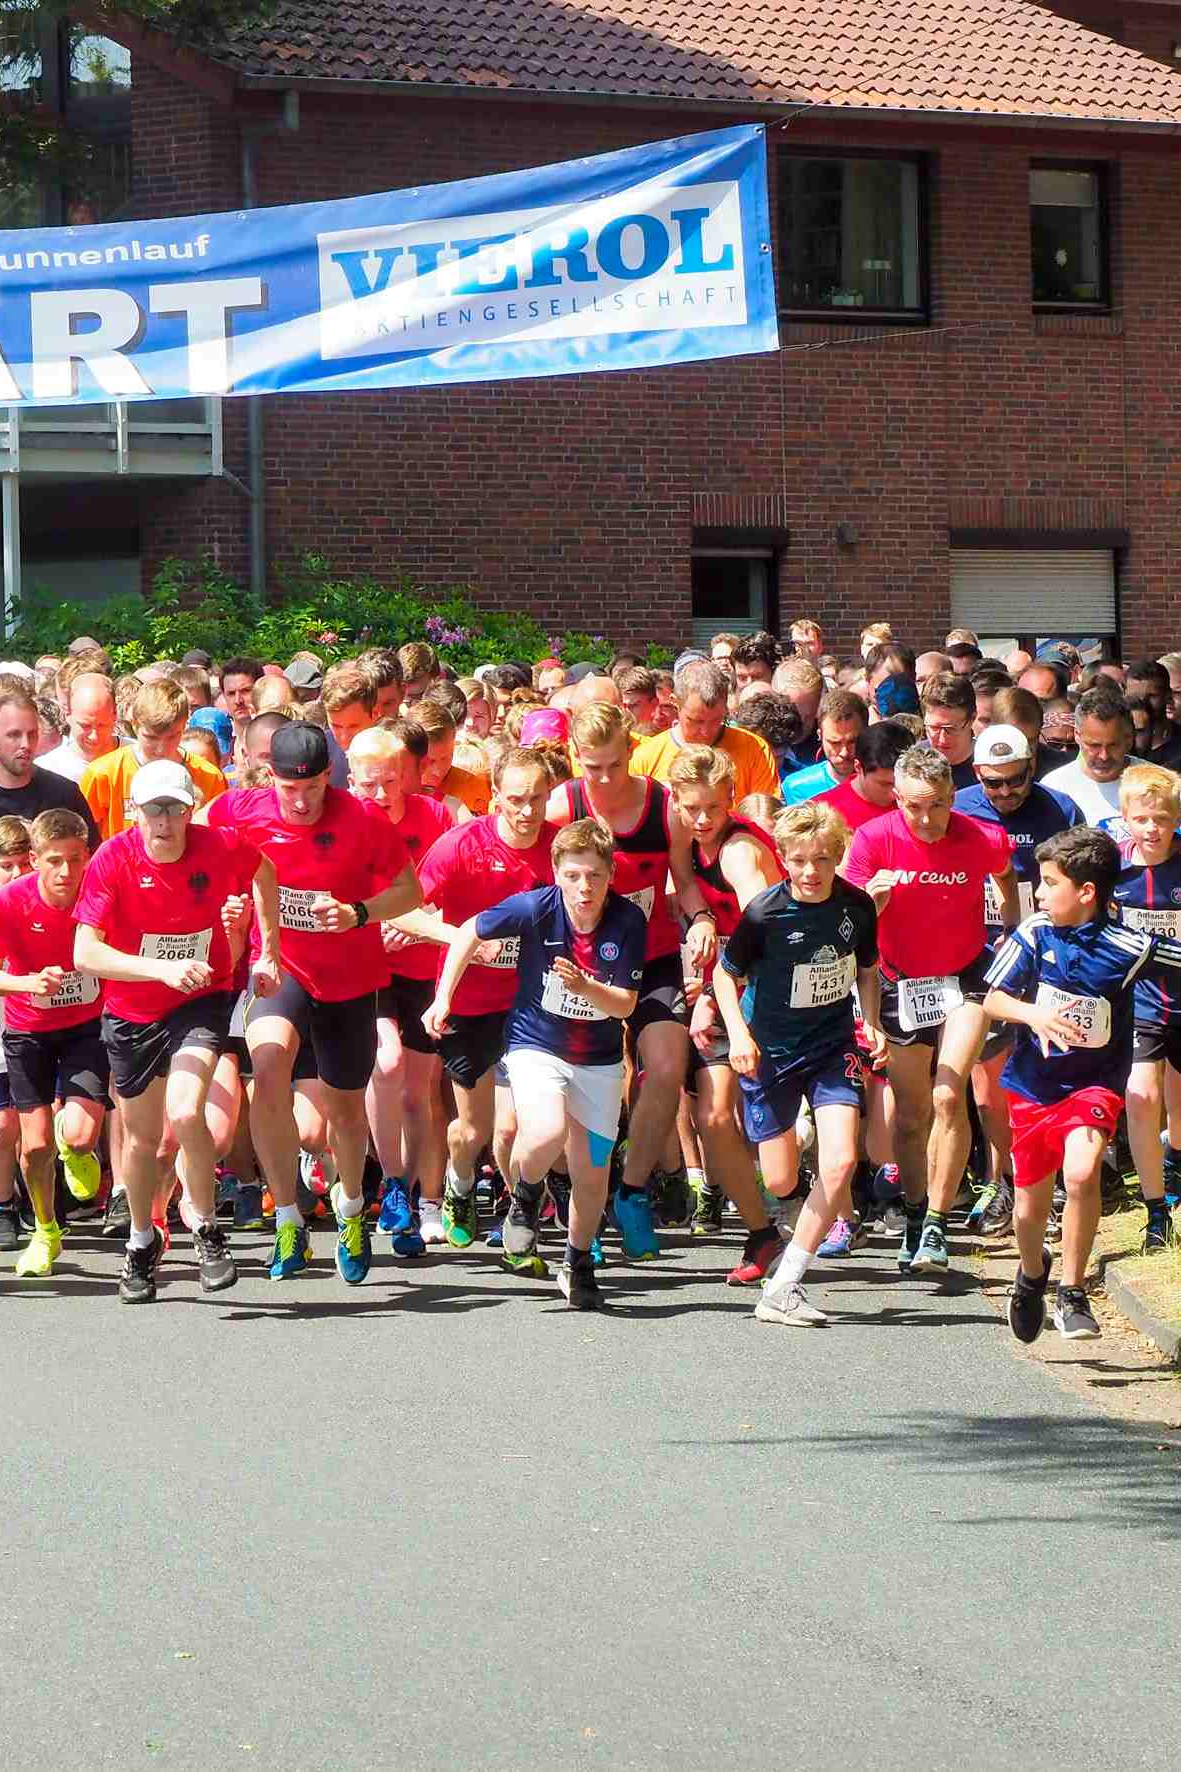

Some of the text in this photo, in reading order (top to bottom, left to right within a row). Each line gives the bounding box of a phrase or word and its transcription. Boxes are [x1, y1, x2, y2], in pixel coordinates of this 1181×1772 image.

[330, 206, 735, 301] VIEROL
[356, 284, 737, 335] KTIENGESELLSCHAFT
[1008, 833, 1035, 844] ROL
[918, 871, 969, 885] cewe
[155, 948, 196, 961] 2068
[58, 983, 82, 996] 061
[811, 973, 845, 993] 1431
[50, 995, 83, 1006] bruns
[811, 989, 843, 1004] bruns
[910, 991, 946, 1010] 1794
[560, 1003, 594, 1017] bruns
[914, 1008, 947, 1024] bruns
